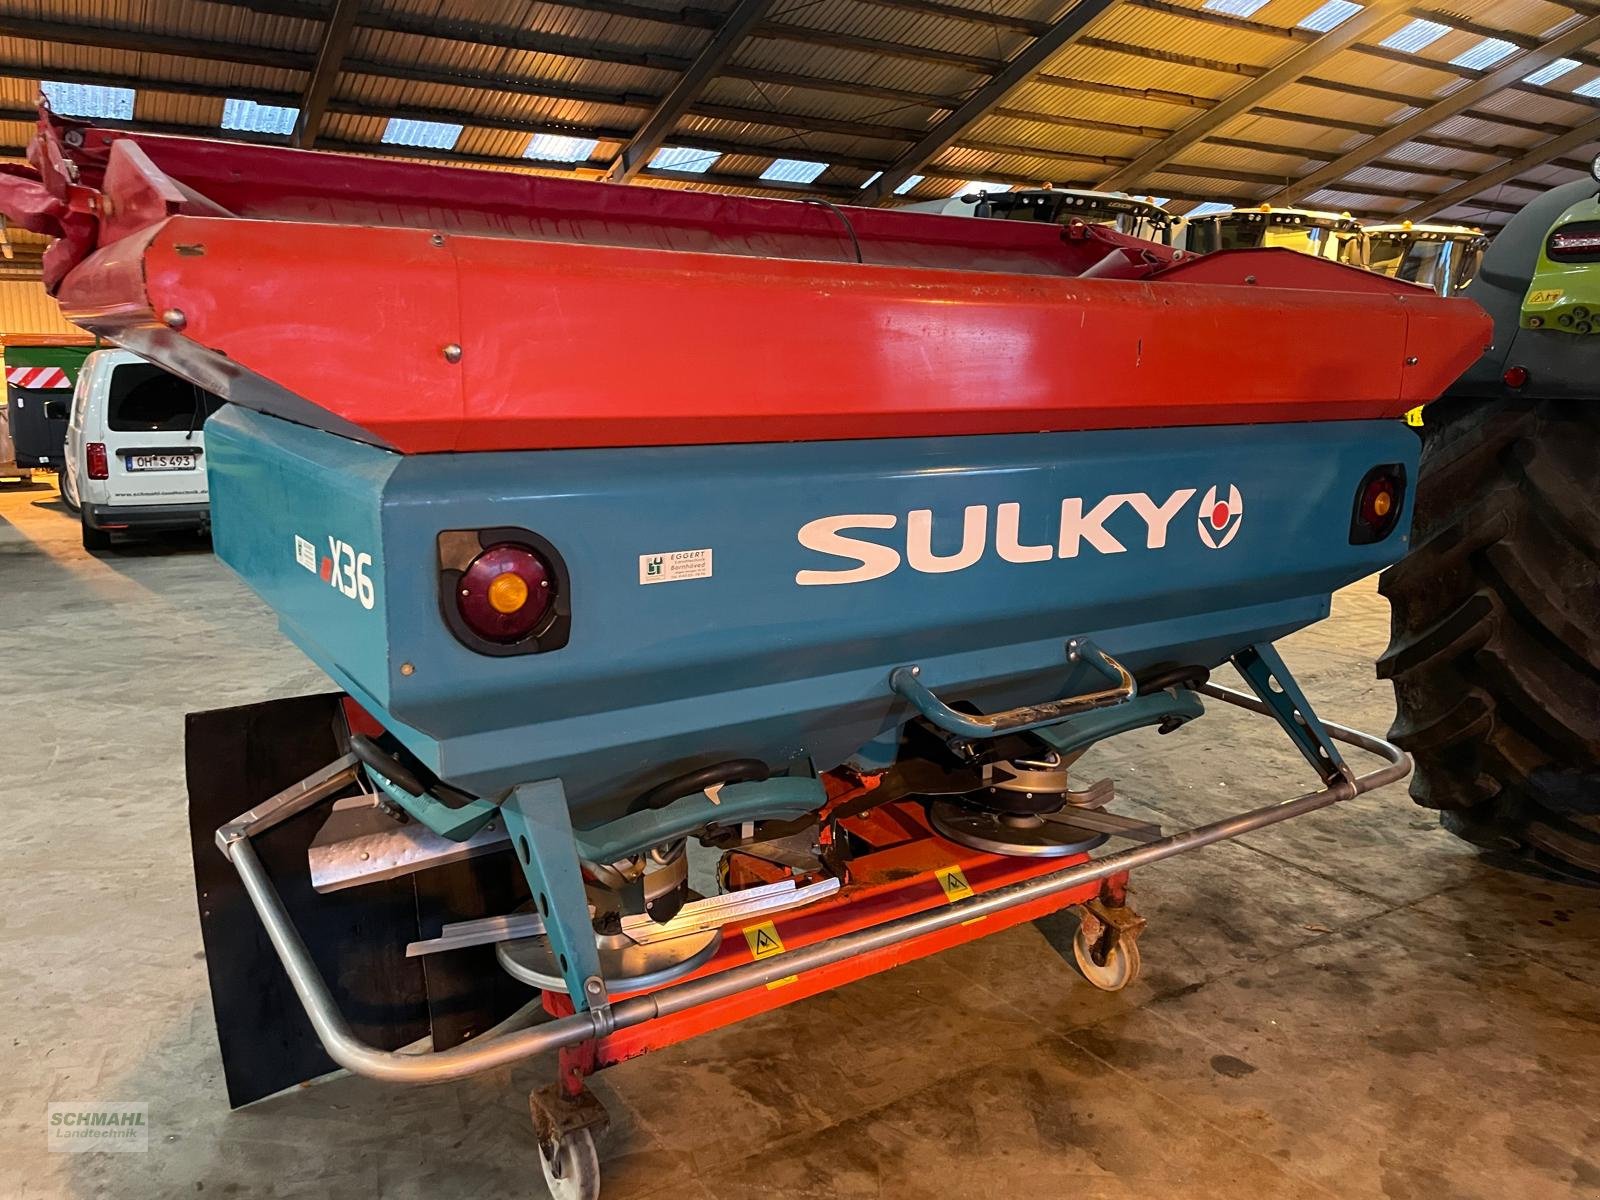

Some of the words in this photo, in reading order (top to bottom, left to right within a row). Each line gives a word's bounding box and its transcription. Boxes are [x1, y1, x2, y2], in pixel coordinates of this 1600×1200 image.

[137, 457, 153, 467] OH
[160, 456, 167, 467] S
[169, 456, 190, 466] 493
[671, 551, 705, 560] EGGERT
[795, 488, 1197, 586] SULKY
[328, 535, 375, 610] X36
